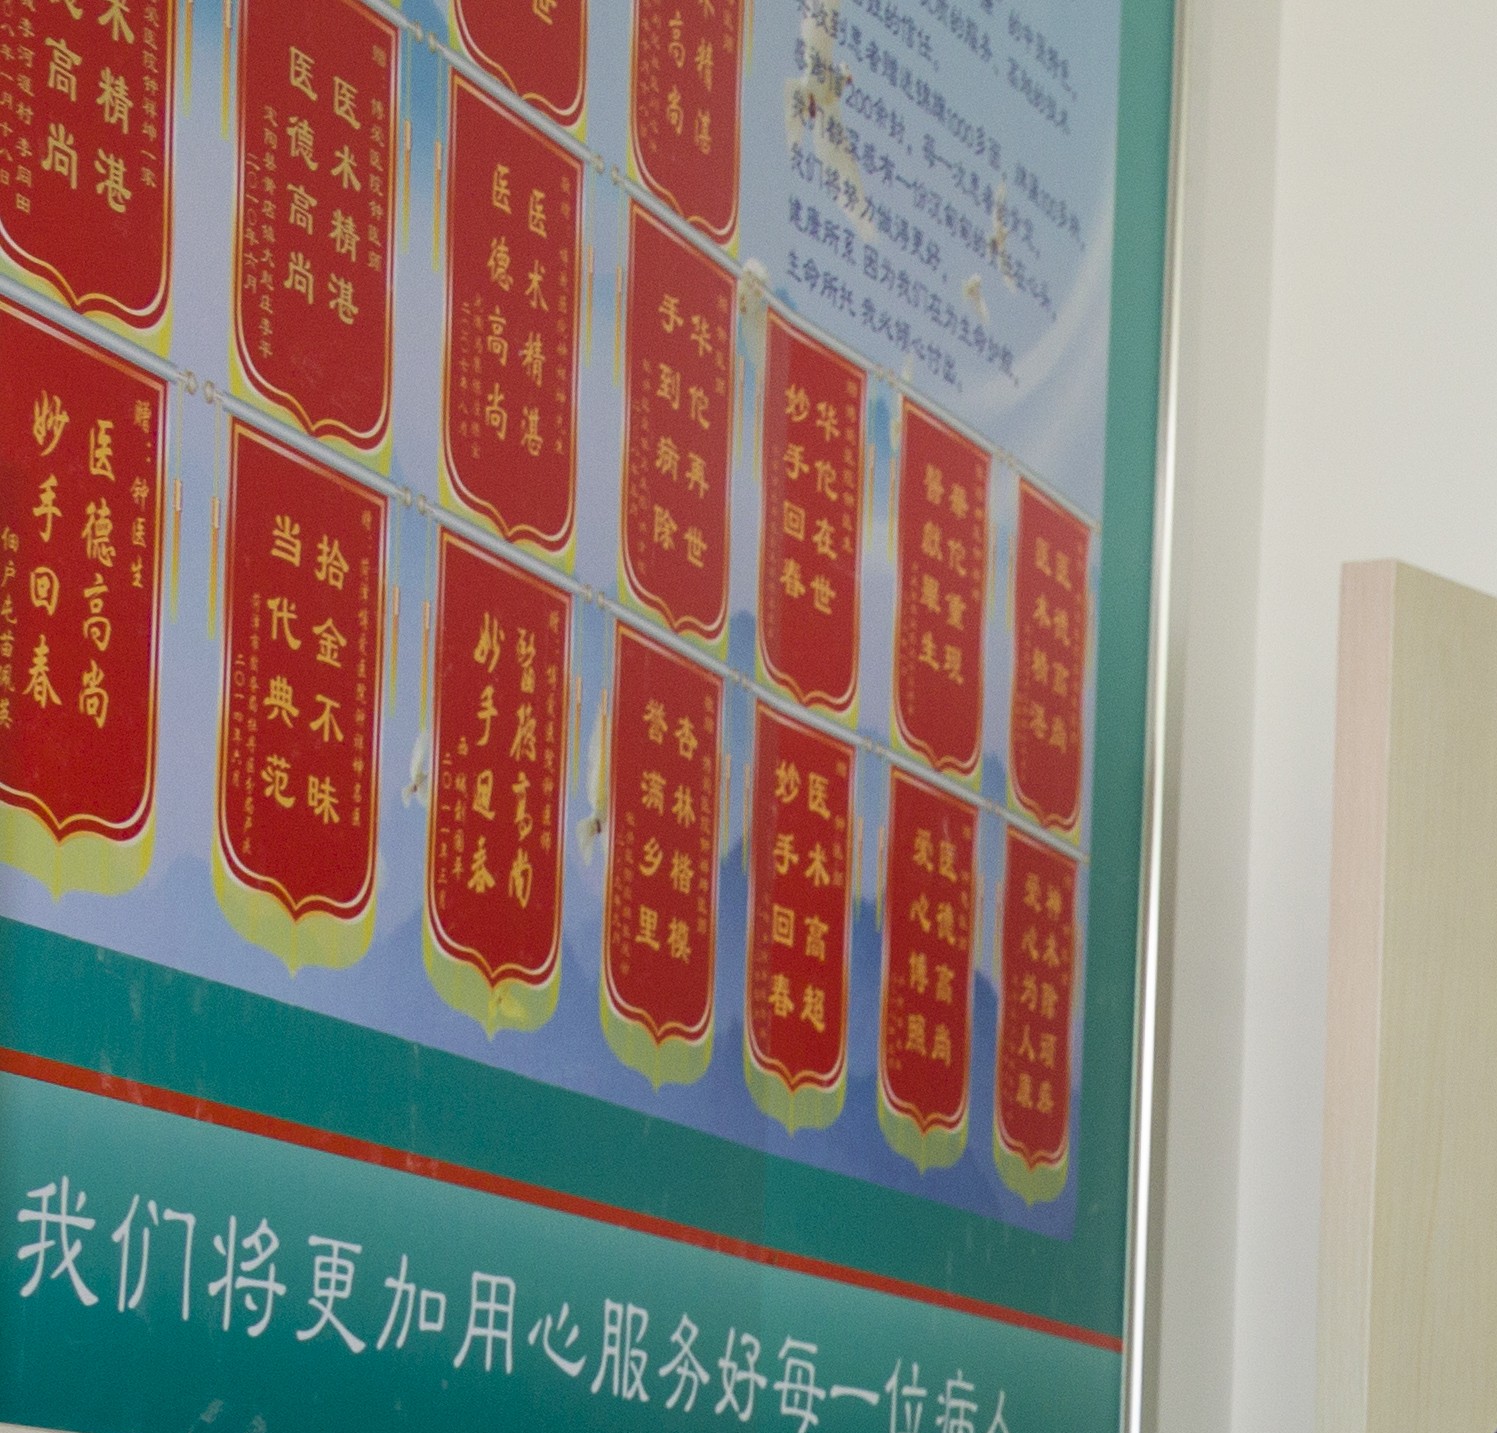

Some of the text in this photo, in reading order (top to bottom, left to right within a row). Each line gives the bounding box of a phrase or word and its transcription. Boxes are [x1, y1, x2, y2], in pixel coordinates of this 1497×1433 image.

[41, 0, 83, 190] 高尚
[284, 46, 319, 305] 医德高尚
[328, 76, 361, 325] 医术精湛
[485, 163, 514, 442] 医德高尚
[653, 292, 684, 552] 手到病除
[22, 389, 70, 710] 妙手回春
[79, 419, 116, 730] 医德高尚
[780, 383, 810, 600] 妙手回春
[259, 514, 302, 810] 当代典范
[306, 534, 350, 826] 拾金不昧
[666, 716, 699, 966] 杏林楷模
[768, 760, 801, 1019] 妙手回春
[800, 771, 833, 1034] 医术高超
